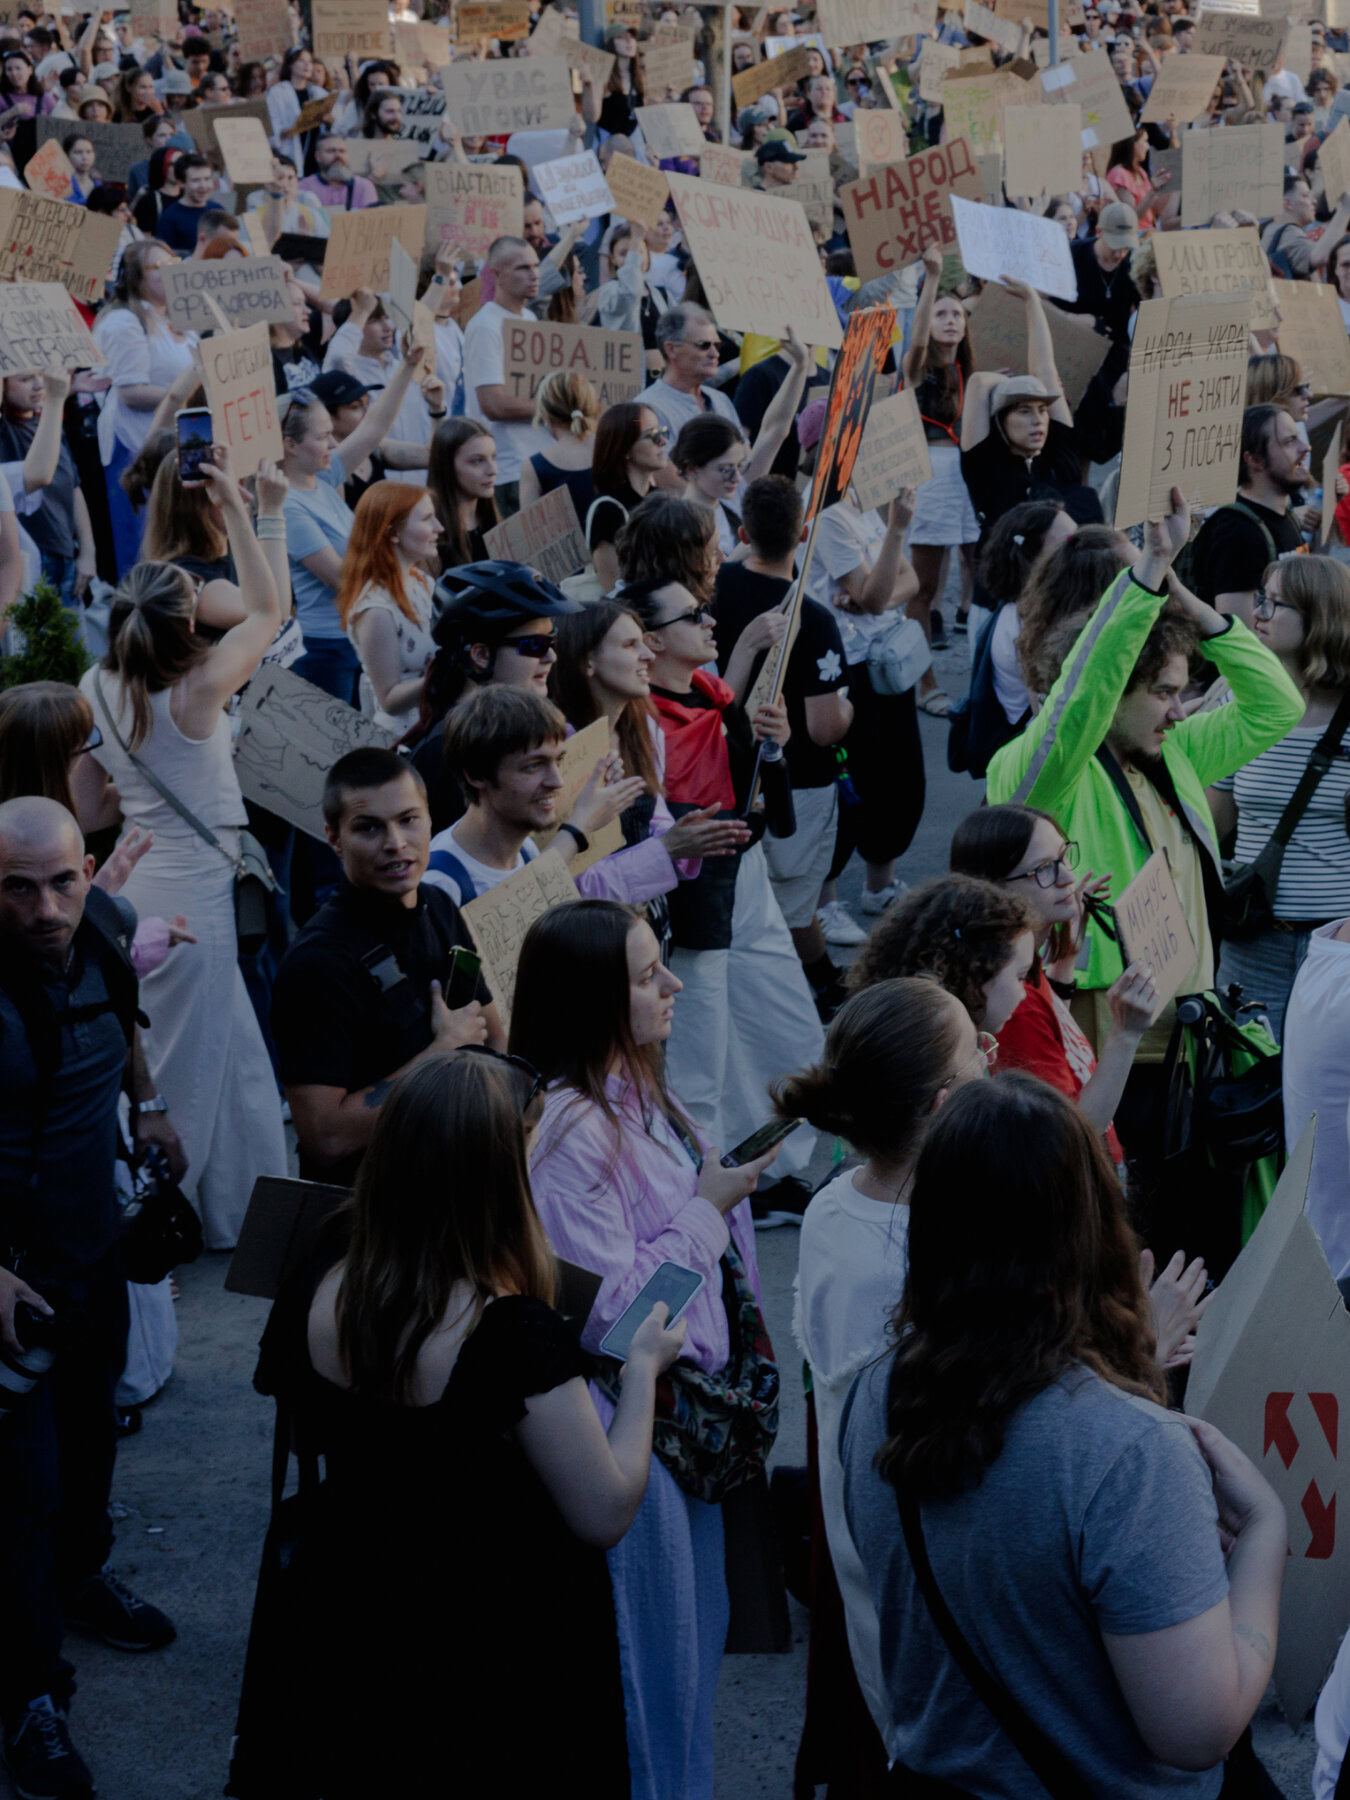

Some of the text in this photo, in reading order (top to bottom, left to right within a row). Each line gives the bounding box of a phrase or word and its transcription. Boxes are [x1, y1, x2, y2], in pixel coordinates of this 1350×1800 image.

[852, 136, 976, 219] НАРОД
[900, 190, 942, 230] НЕ
[1168, 243, 1210, 274] МИ
[511, 327, 633, 373] ВОВА, НЕ
[1167, 374, 1242, 419] НЕ ЗНЯТИ
[1161, 430, 1175, 472] З
[1126, 867, 1168, 942] МІНУС
